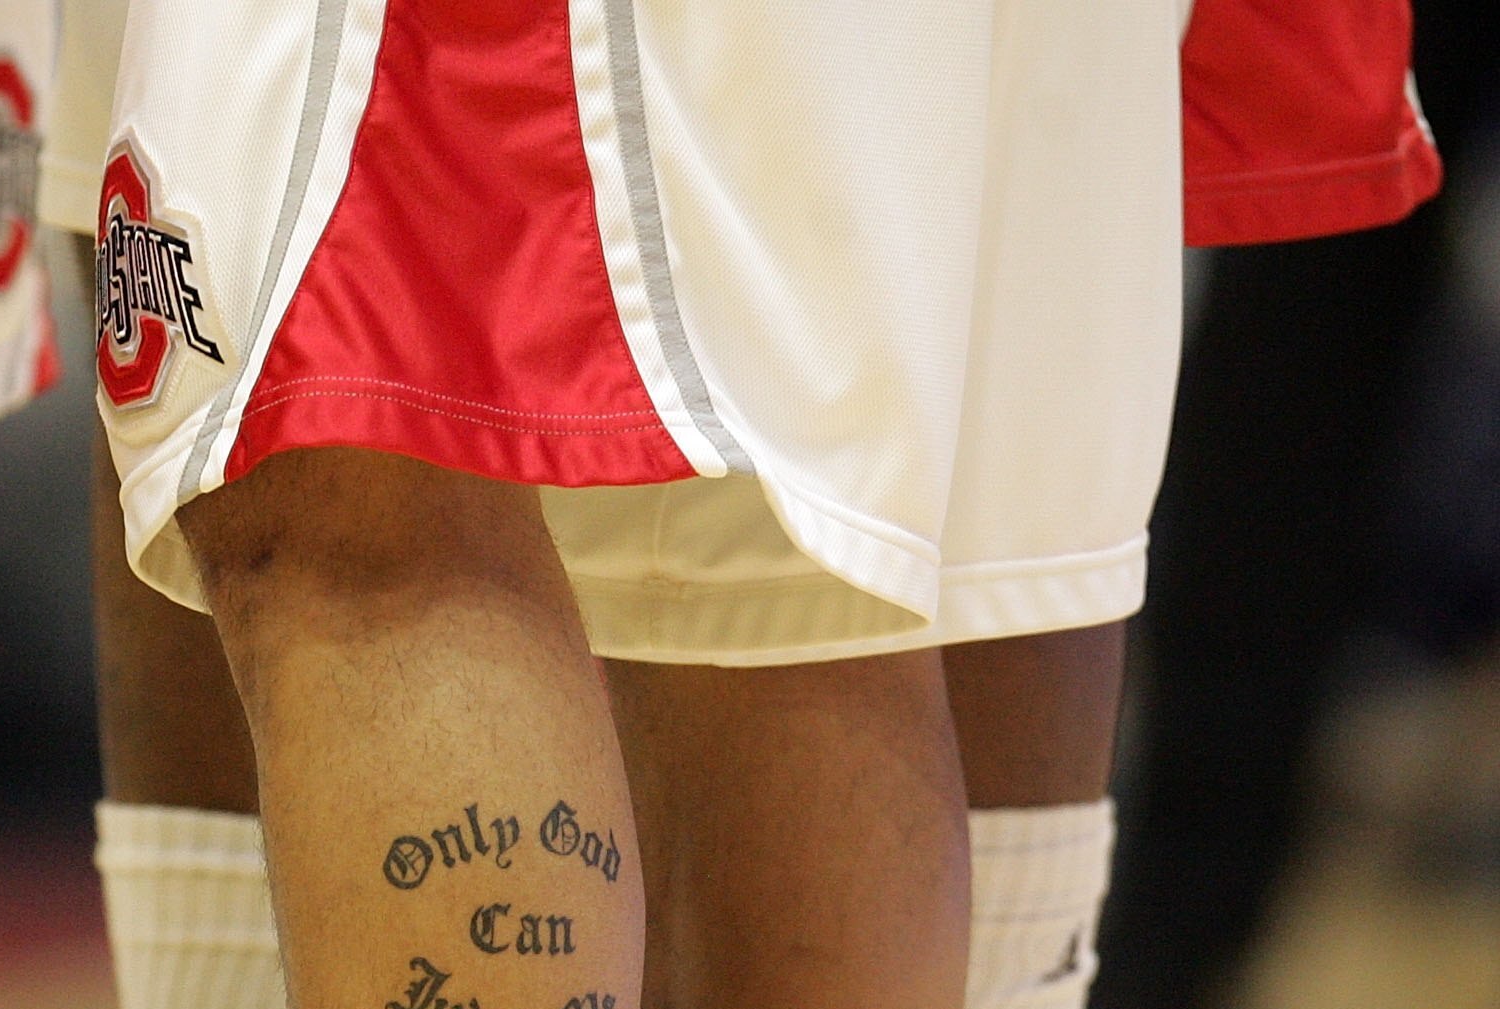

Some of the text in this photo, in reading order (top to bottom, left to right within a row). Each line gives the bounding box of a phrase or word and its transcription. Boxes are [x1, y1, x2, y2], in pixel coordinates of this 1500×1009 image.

[383, 799, 621, 890] Only God
[470, 902, 576, 955] Can
